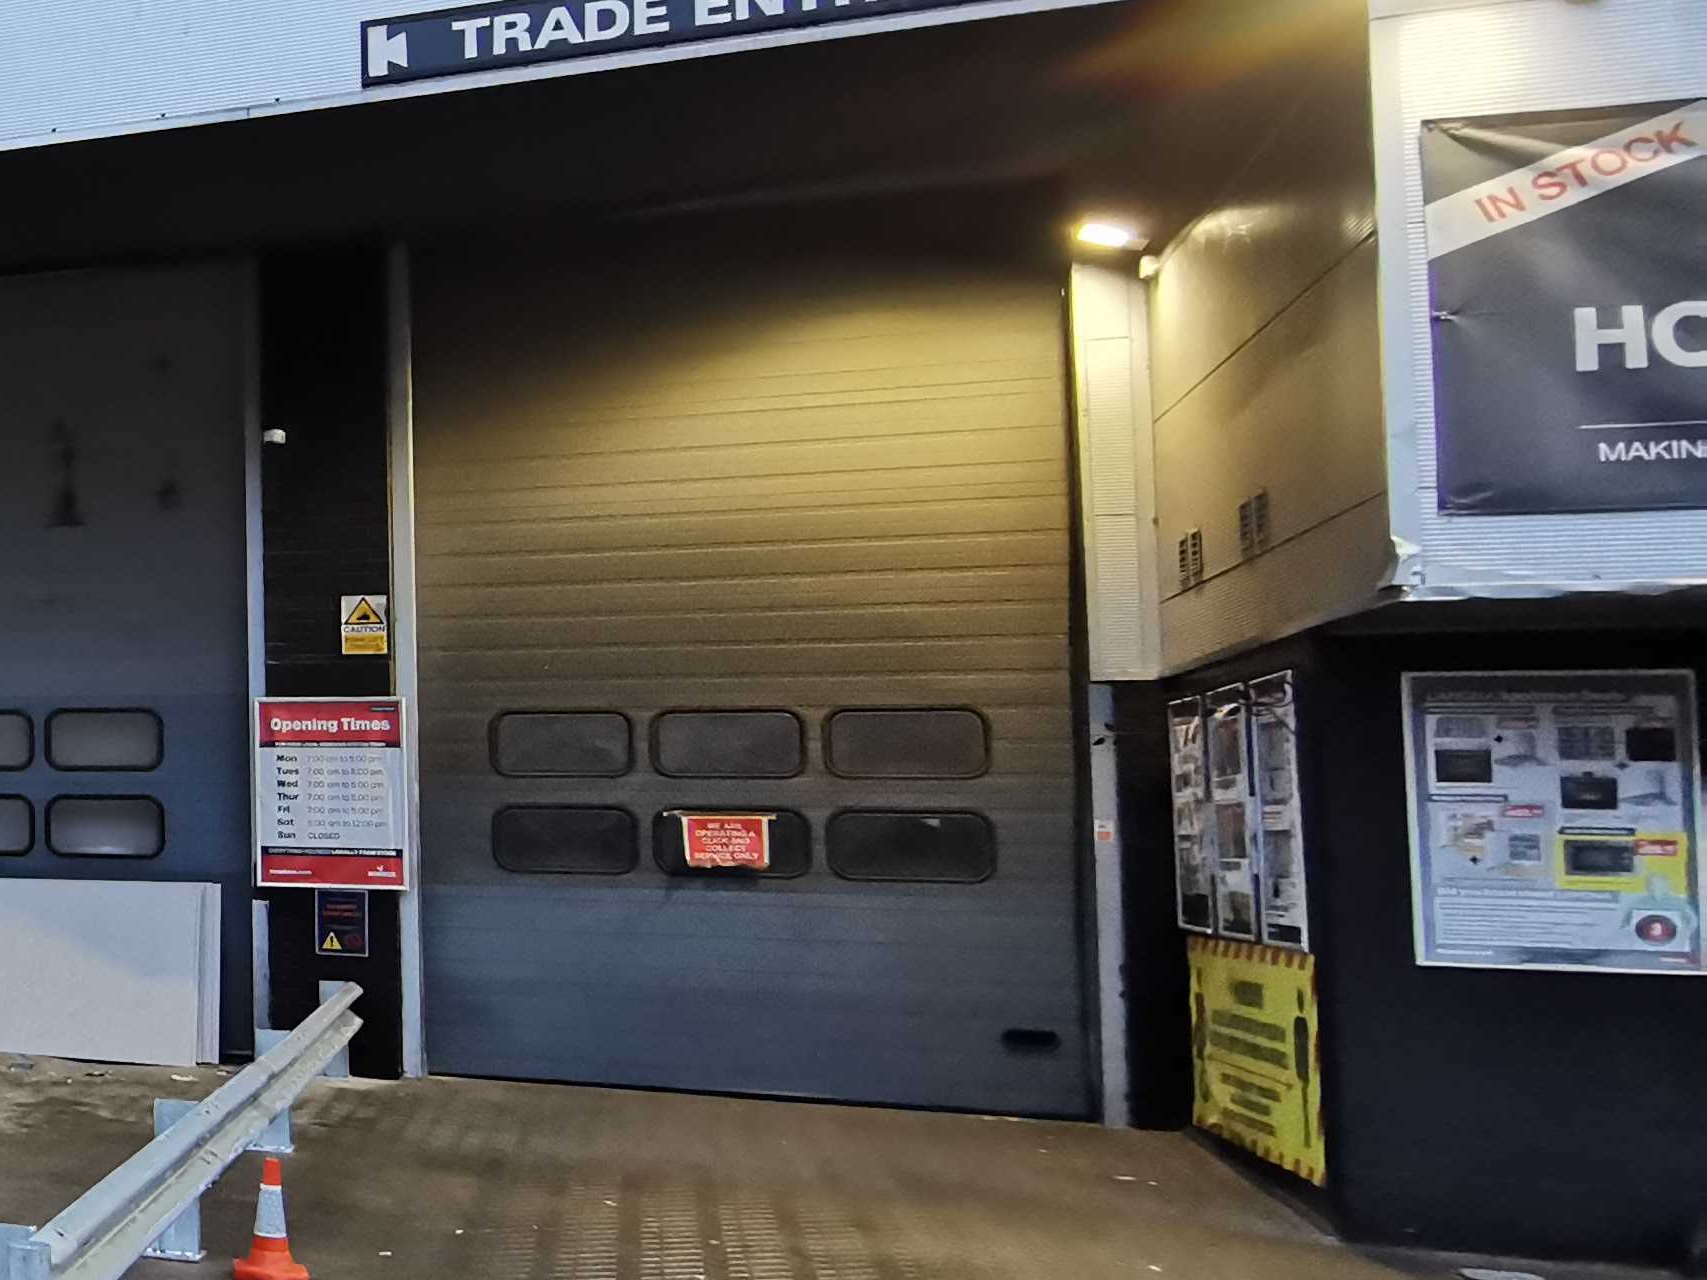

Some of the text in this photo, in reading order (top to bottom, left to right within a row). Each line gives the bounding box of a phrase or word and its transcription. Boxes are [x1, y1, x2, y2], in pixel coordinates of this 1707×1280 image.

[1474, 121, 1700, 222] IN STOCK
[270, 717, 391, 733] Opening Times
[276, 754, 297, 762] Mon
[276, 767, 299, 775] Tues
[277, 780, 298, 788] Wed
[277, 792, 299, 800] Thur
[277, 805, 290, 813] Fri
[277, 818, 295, 826] Sat
[277, 831, 296, 839] Sun
[695, 829, 748, 837] OPERATING
[733, 852, 759, 860] ONLY
